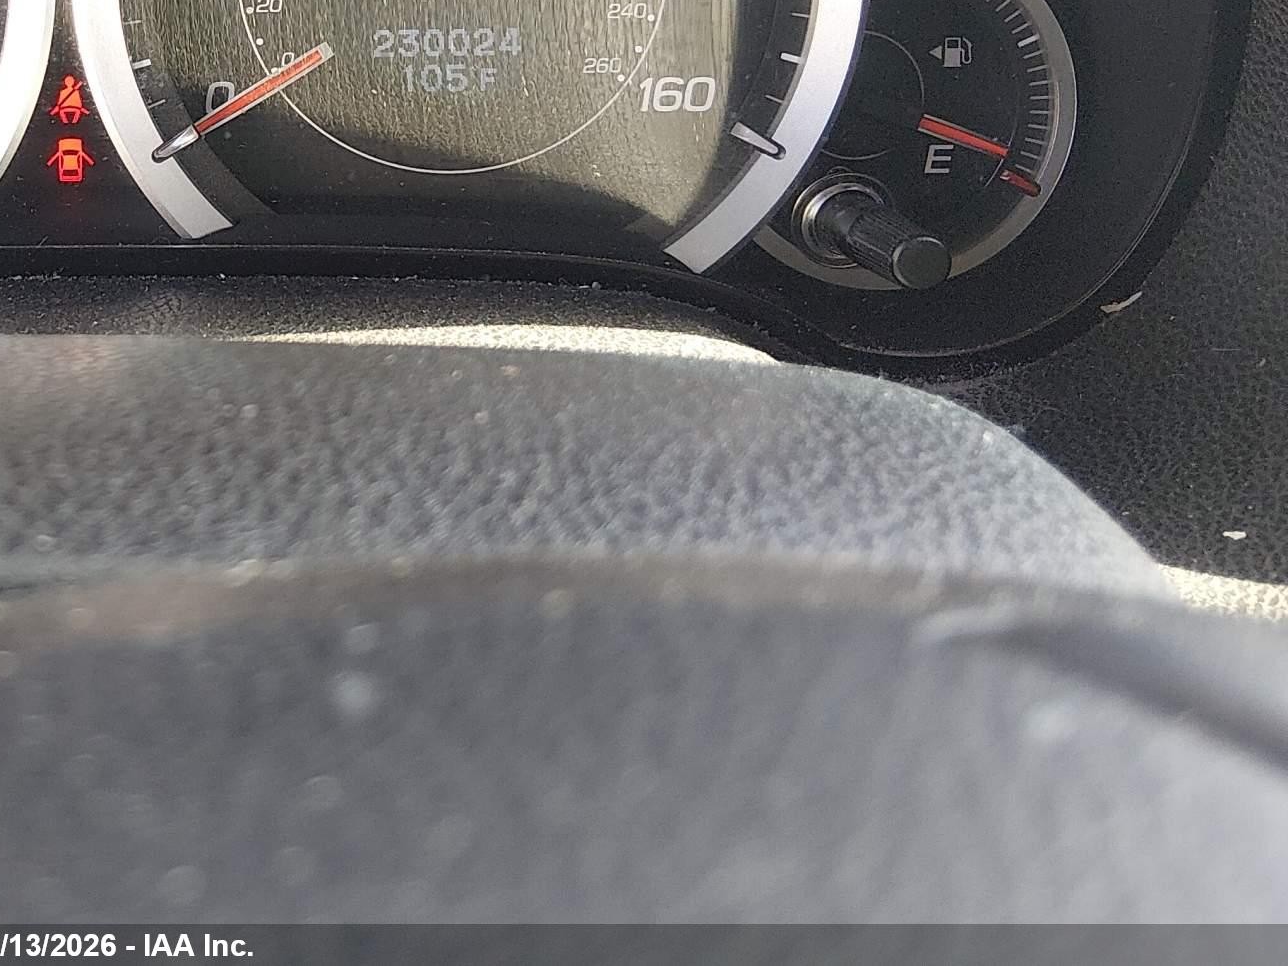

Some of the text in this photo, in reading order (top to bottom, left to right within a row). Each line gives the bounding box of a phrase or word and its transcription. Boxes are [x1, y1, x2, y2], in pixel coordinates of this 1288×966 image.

[608, 4, 646, 20] 240
[372, 27, 523, 58] 230024
[583, 57, 622, 74] 260
[639, 76, 715, 112] 160
[924, 144, 954, 174] E
